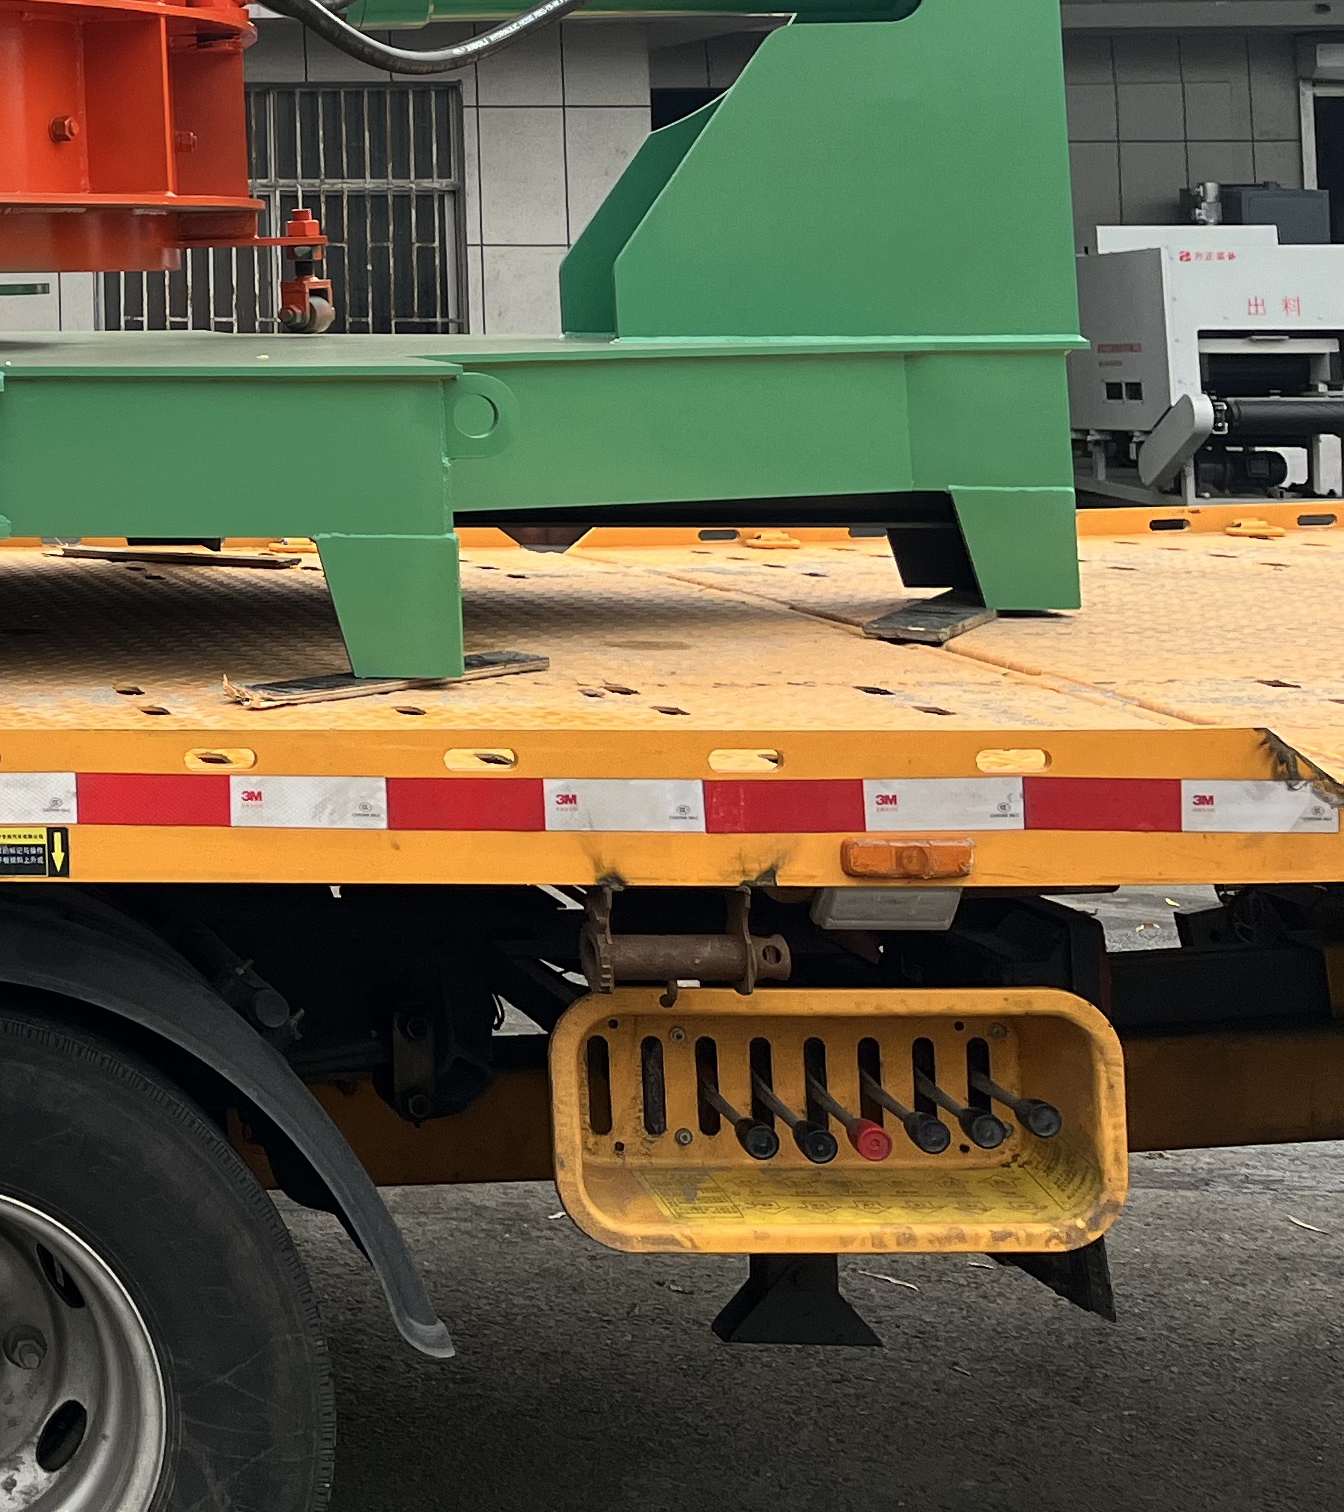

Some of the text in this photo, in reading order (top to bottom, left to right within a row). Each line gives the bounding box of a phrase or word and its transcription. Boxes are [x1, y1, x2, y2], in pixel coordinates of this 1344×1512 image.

[1247, 296, 1301, 317] 出料
[241, 790, 263, 802] 3M
[555, 793, 578, 805] 3M
[875, 794, 898, 806] 3M
[1192, 794, 1215, 806] 3M
